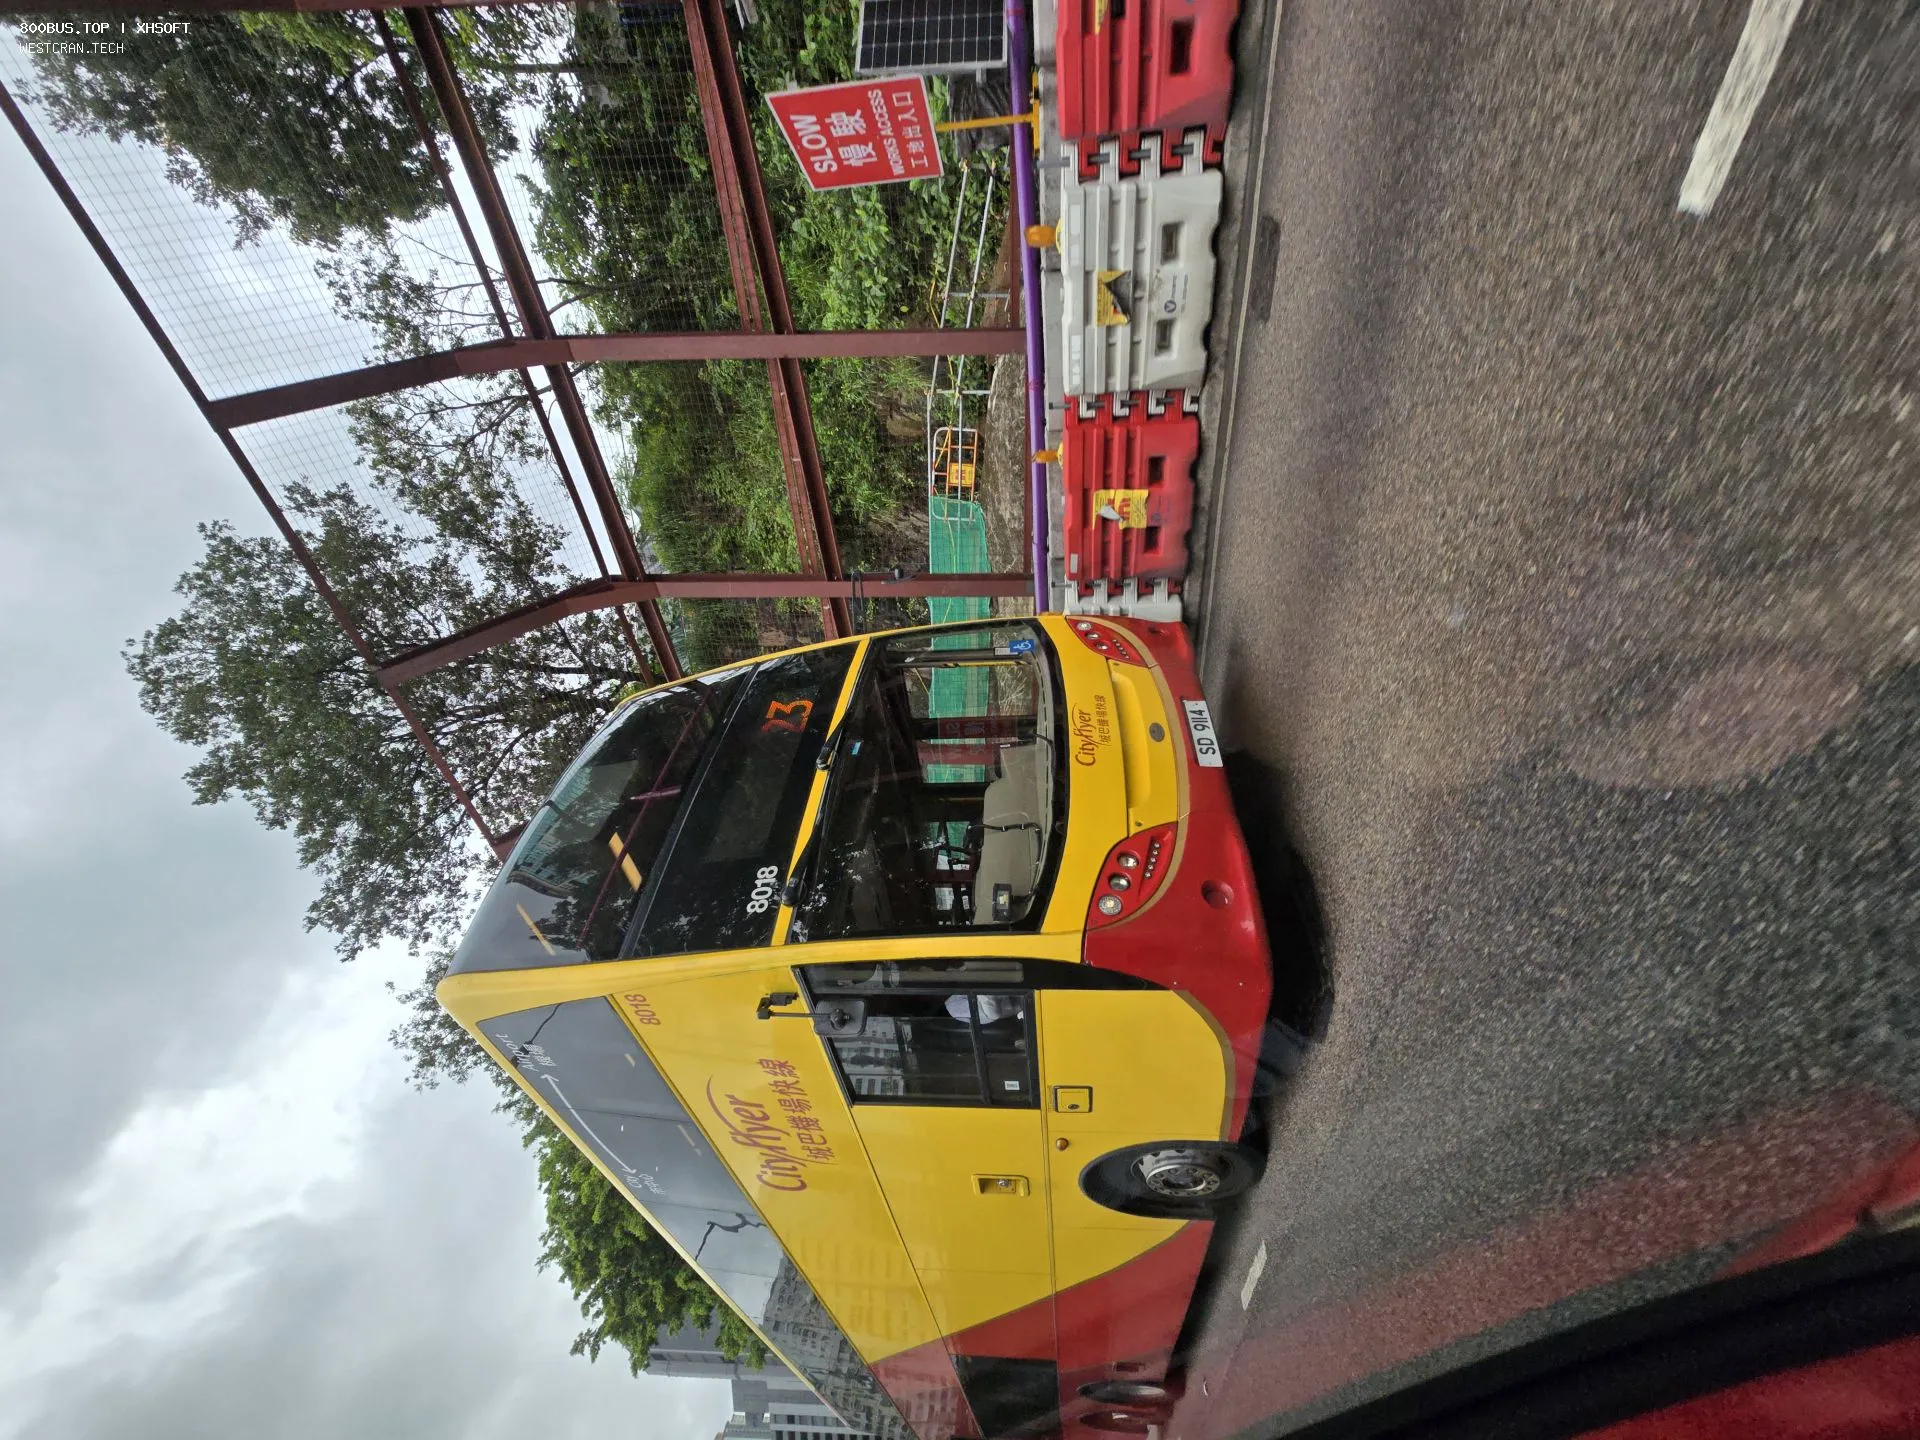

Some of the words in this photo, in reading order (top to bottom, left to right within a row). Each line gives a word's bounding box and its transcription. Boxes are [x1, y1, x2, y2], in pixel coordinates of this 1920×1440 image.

[867, 88, 894, 137] ACCESS
[891, 91, 928, 168] 工地出入口
[789, 114, 838, 174] SLOW
[825, 108, 878, 167] 慢駛
[883, 138, 905, 176] WORKS
[1188, 709, 1211, 732] 9114
[1196, 737, 1217, 756] SD
[746, 865, 778, 914] 8018
[624, 993, 662, 1027] 8018
[495, 1033, 539, 1071] Airport
